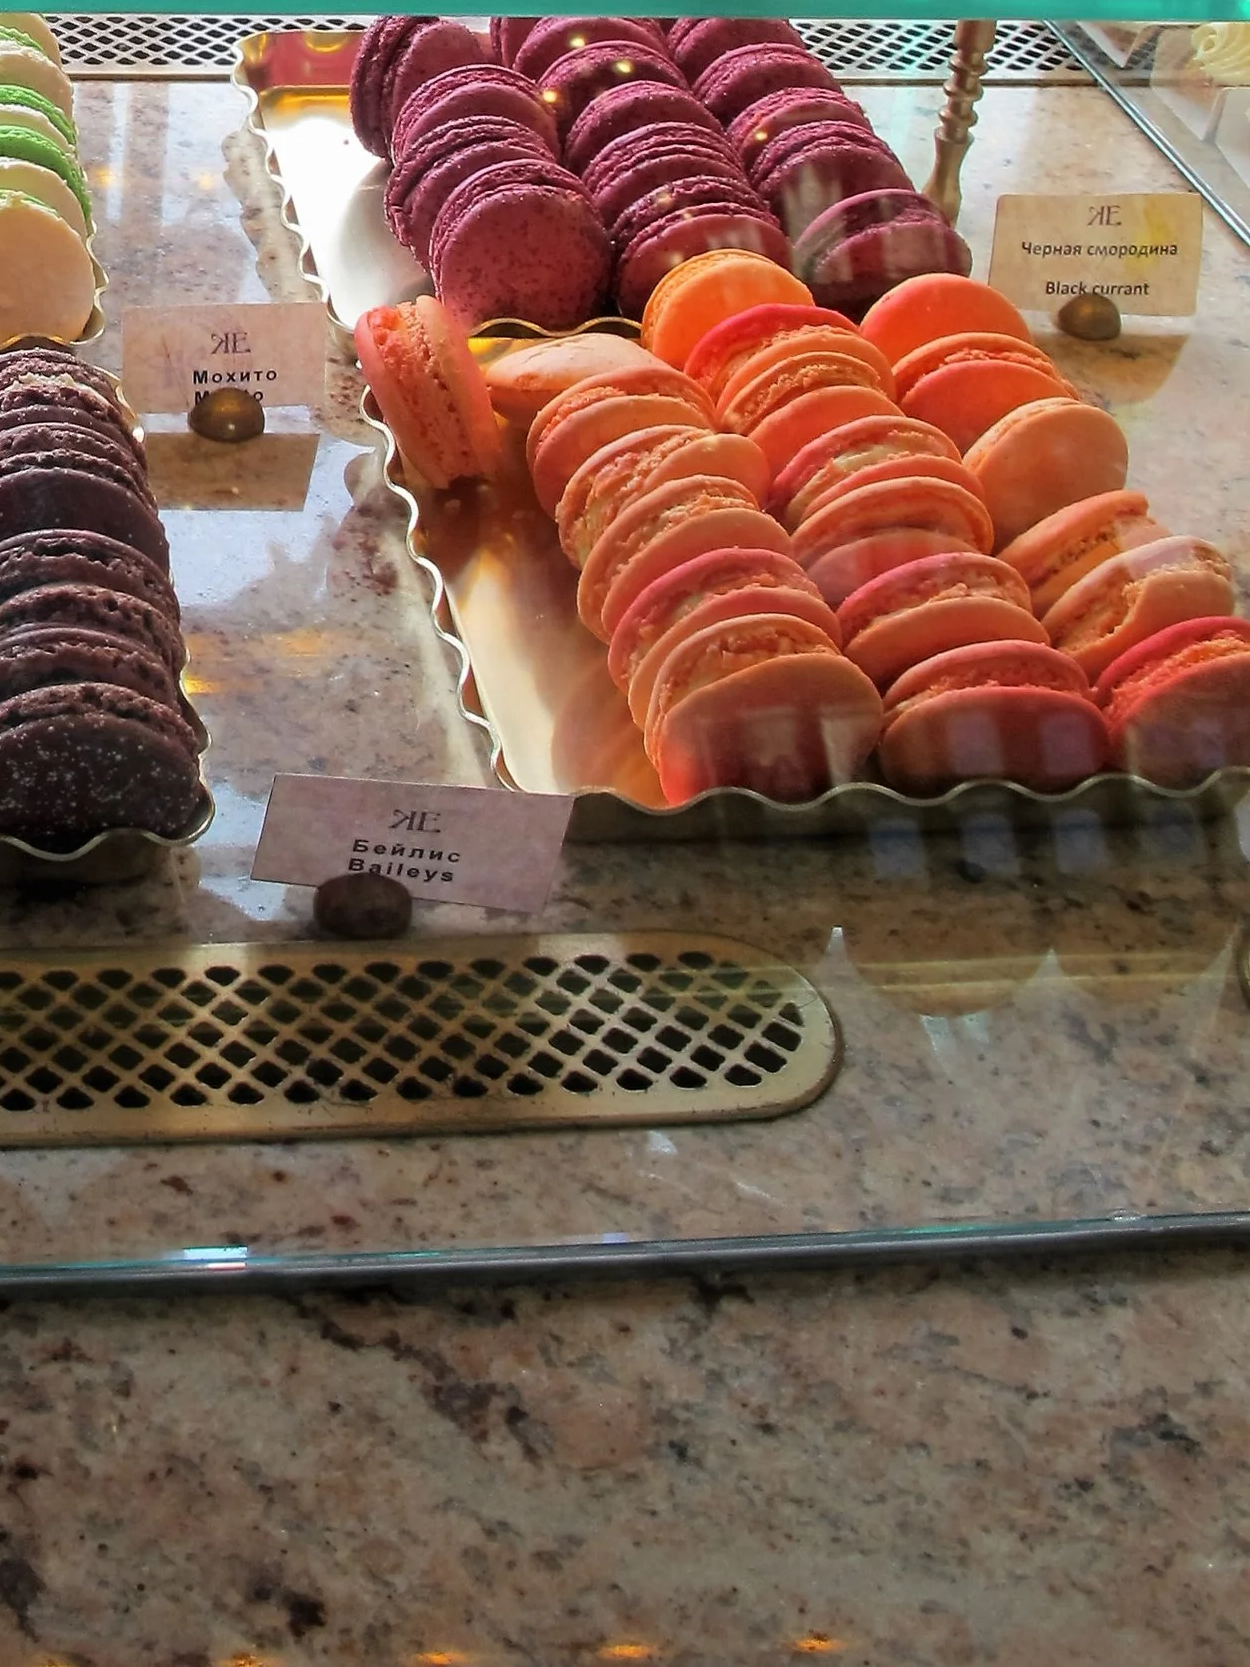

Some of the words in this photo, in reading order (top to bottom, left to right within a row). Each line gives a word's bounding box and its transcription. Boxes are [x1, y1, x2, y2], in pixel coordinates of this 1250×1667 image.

[1021, 240, 1082, 258] Черная
[1086, 242, 1179, 259] смородина
[1045, 281, 1087, 296] Black
[1092, 282, 1150, 297] currant
[192, 368, 278, 385] Мохито
[352, 839, 461, 864] Бейлис
[347, 858, 455, 884] Baileys
